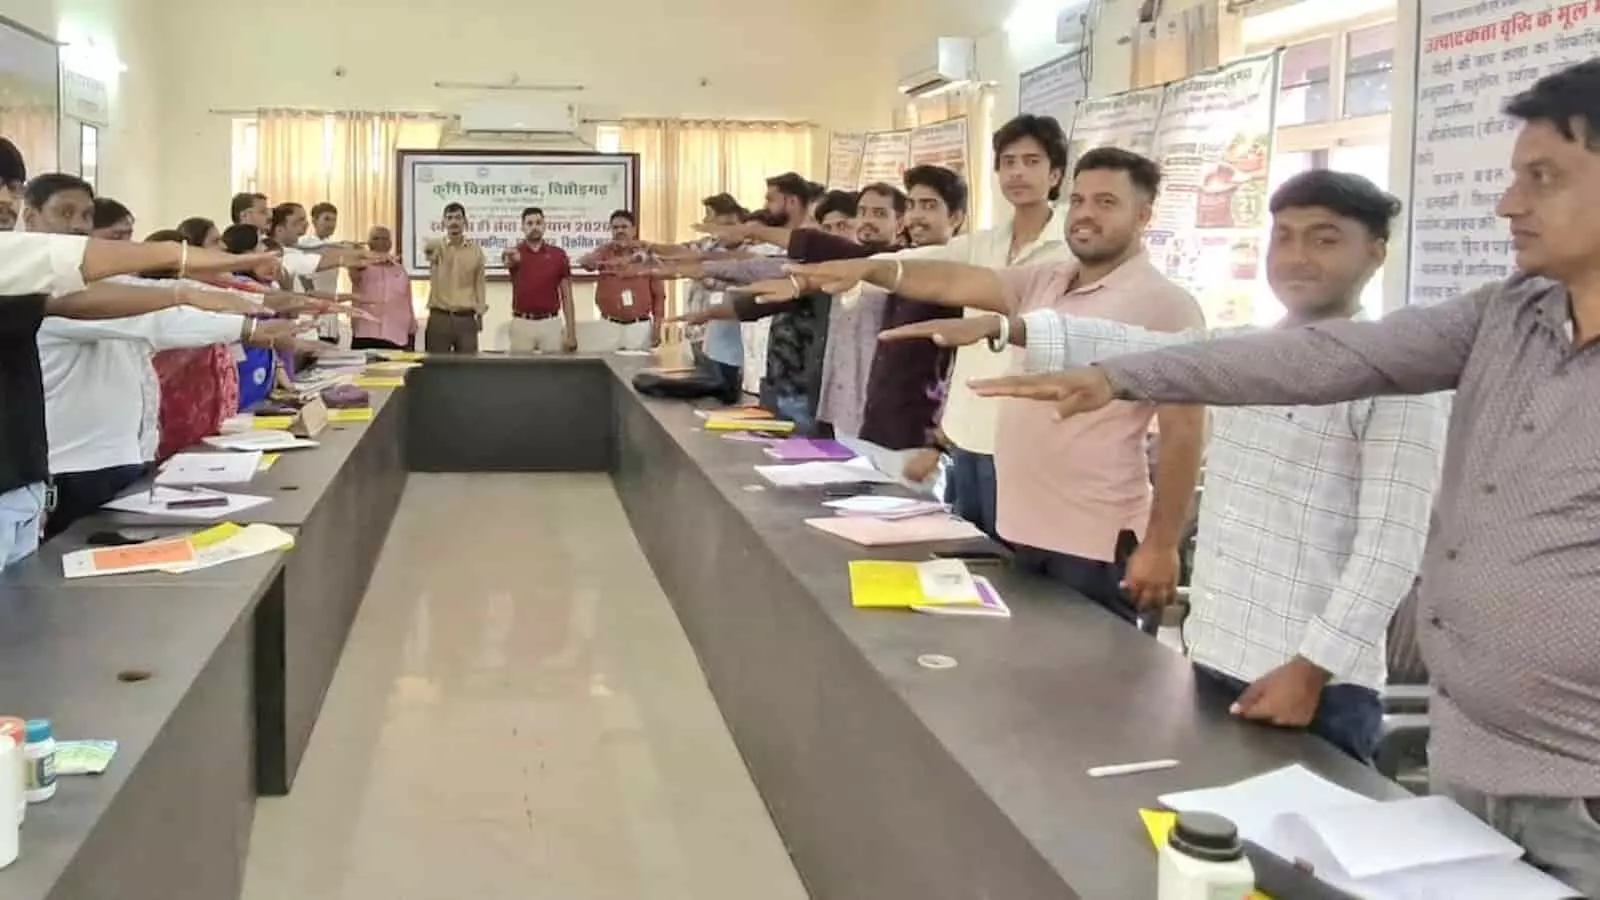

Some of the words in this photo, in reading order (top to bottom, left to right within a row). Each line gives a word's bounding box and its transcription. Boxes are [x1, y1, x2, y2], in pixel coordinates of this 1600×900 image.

[1425, 22, 1497, 54] उत्पादकता
[1500, 11, 1532, 42] वृद्धि
[1557, 1, 1589, 30] मूल
